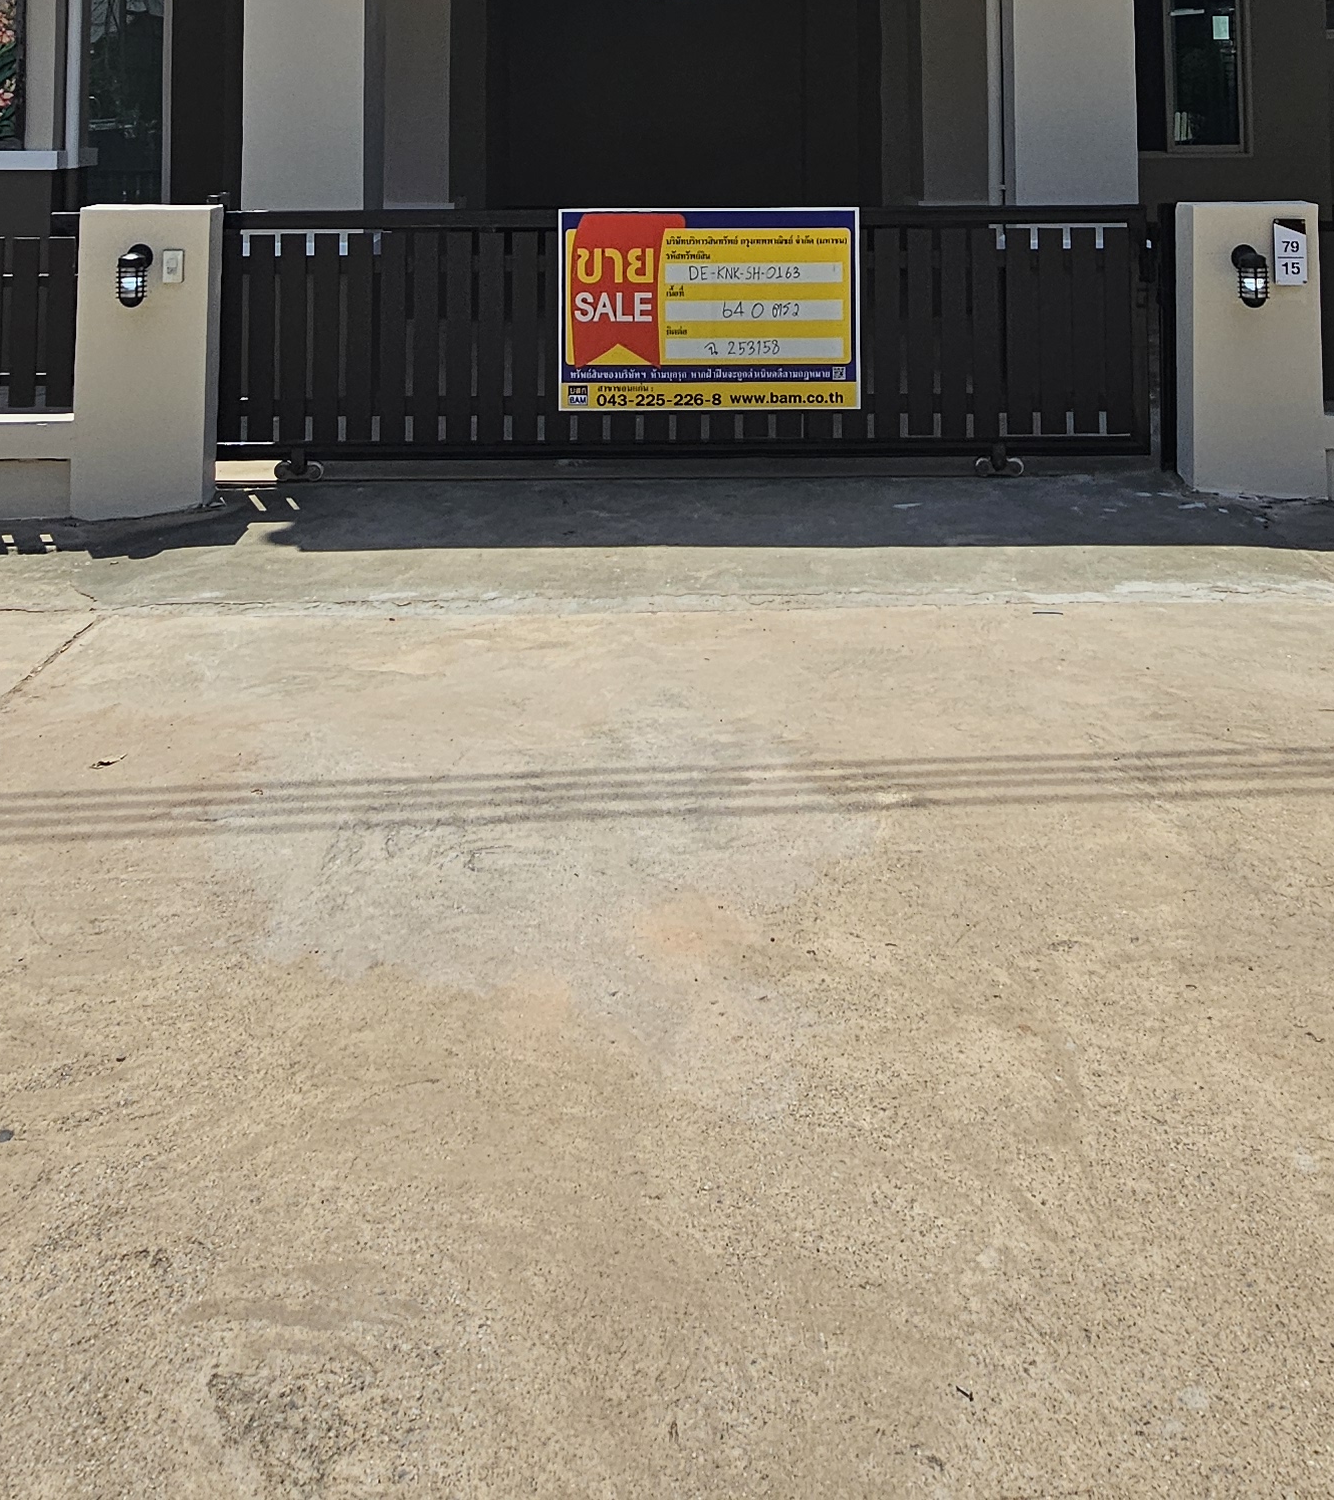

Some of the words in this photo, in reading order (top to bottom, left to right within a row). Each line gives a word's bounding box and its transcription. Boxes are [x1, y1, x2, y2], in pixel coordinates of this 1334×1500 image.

[1281, 240, 1300, 253] 79
[577, 247, 654, 284] ขาย
[688, 265, 801, 281] DE-KNK-SH-0163
[1281, 262, 1301, 275] 15
[574, 291, 653, 322] SALE
[727, 339, 780, 355] 253158
[596, 393, 722, 407] 043-225-226-8
[729, 392, 844, 404] www.bam.co.th
